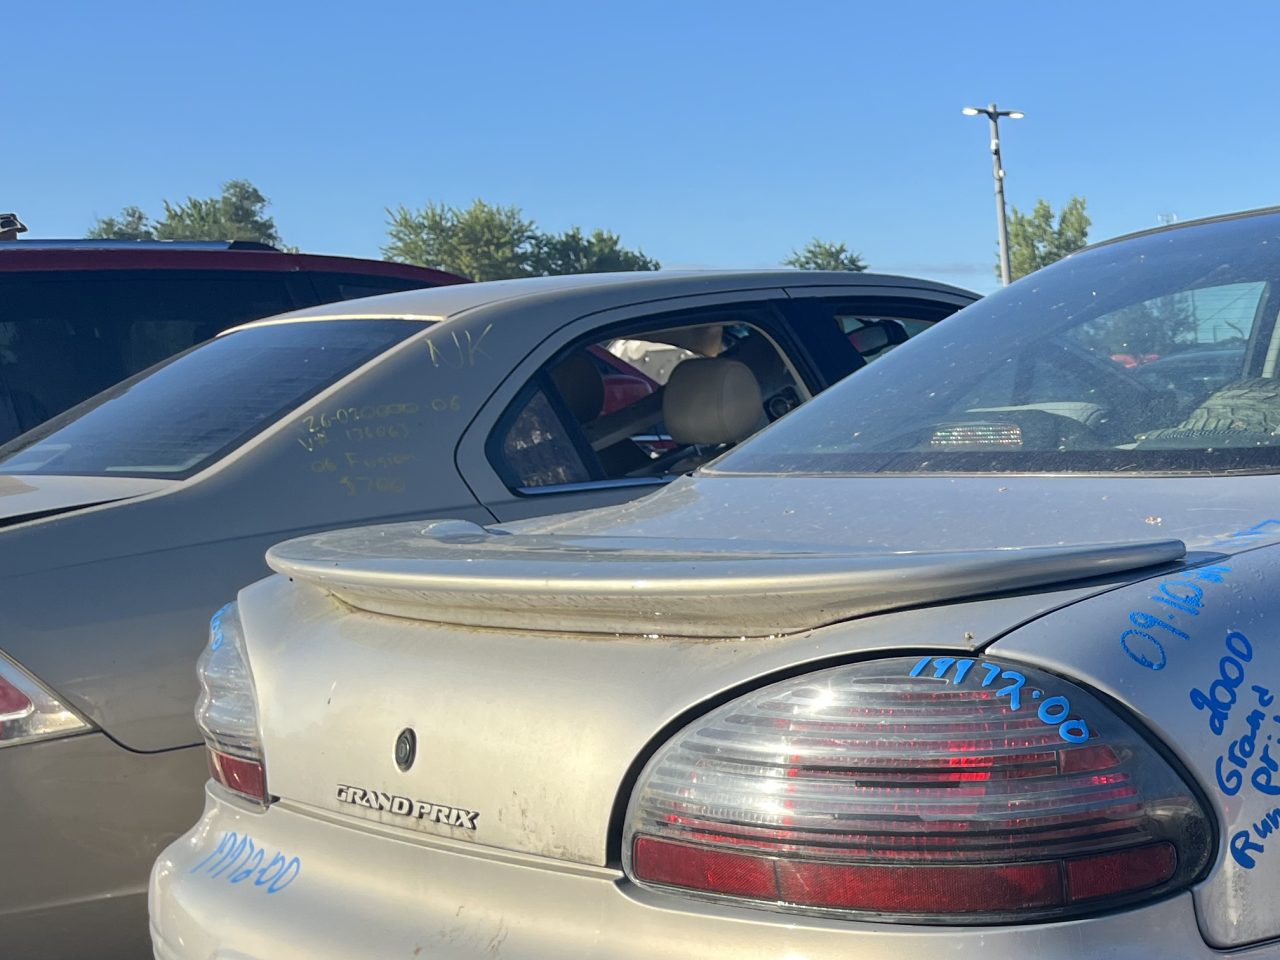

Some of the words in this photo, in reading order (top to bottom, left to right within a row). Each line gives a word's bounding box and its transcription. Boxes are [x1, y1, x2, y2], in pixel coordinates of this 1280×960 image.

[909, 656, 1090, 744] 19972.00
[1189, 631, 1253, 736] 2000
[336, 784, 414, 816] GRAND
[412, 800, 481, 831] PRIX
